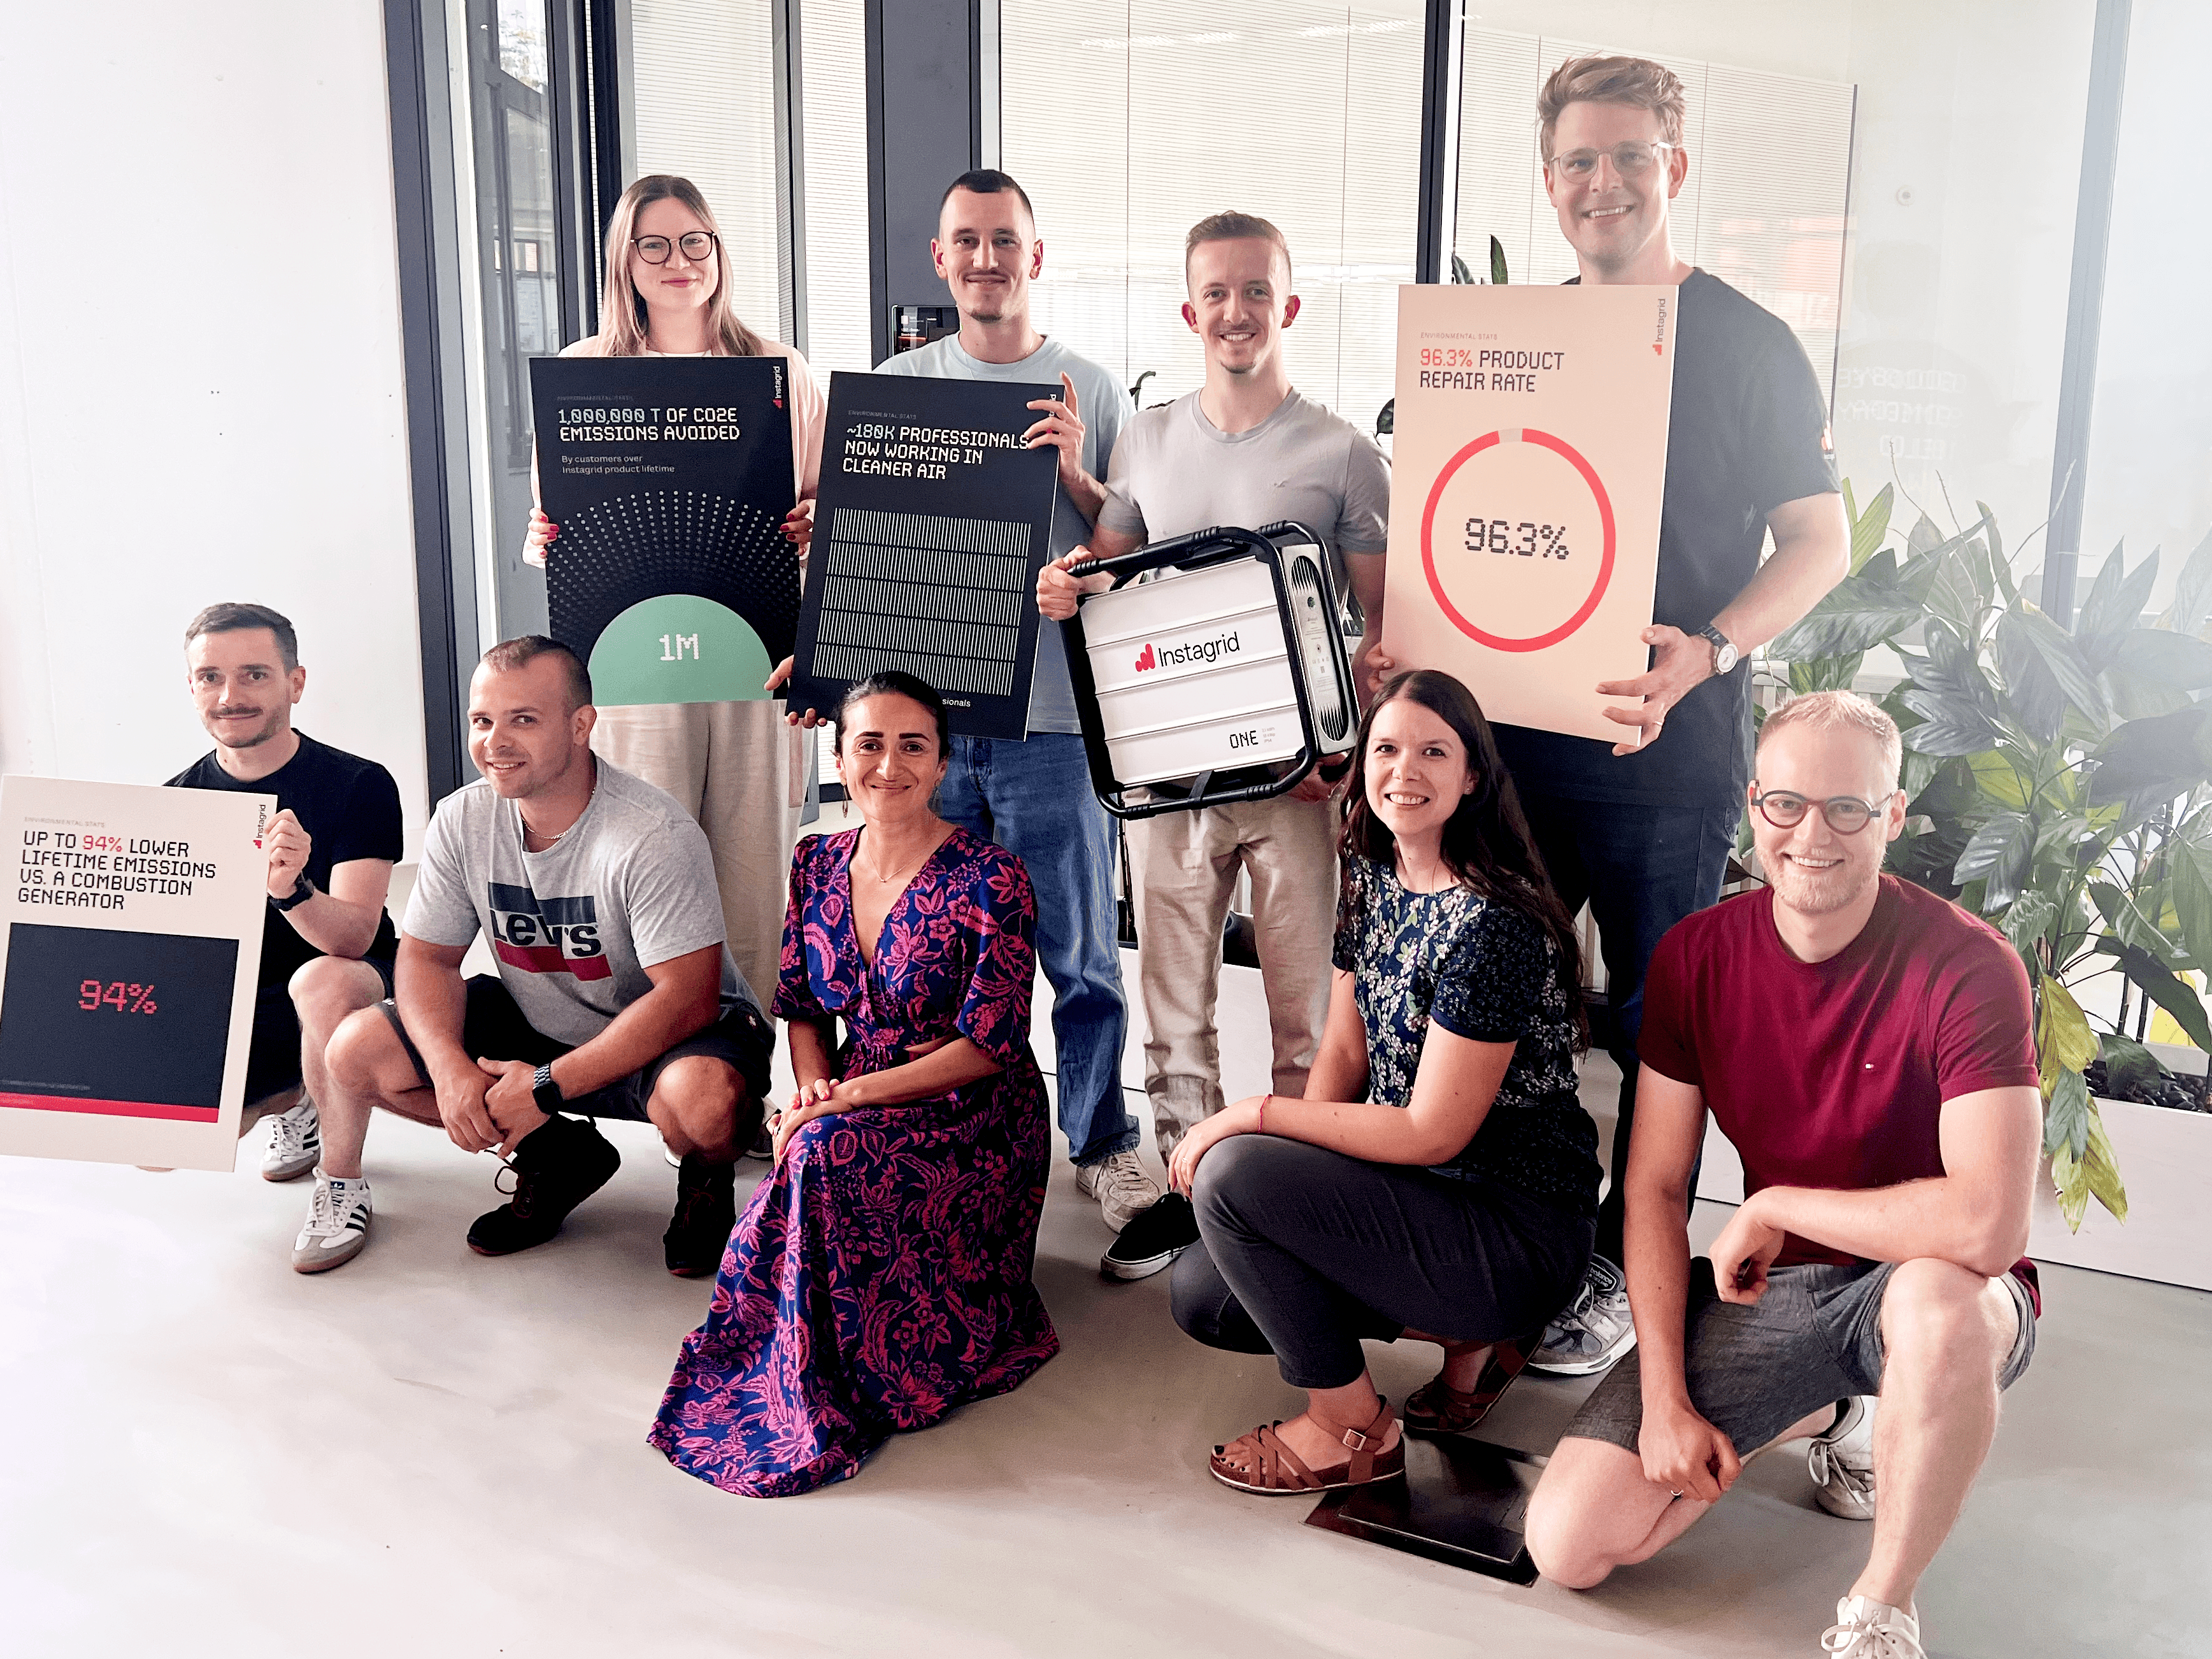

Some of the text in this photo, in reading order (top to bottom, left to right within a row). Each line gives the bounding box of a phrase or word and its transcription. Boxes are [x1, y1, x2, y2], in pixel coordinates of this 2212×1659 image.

[1657, 298, 1667, 342] Instagrid
[1420, 332, 1476, 340] ENVIRONMENTAL
[1420, 349, 1564, 370] 96.3% PRODUCT
[1420, 371, 1536, 392] REPAIR RATE
[558, 408, 737, 425] 1,000,000 T OF CO2E
[560, 425, 740, 441] EMISSIONS AVOIDED
[847, 423, 1029, 450] ~180K PROFESSIONALS
[562, 456, 573, 464] By
[845, 439, 983, 465] NOW WORKING IN
[562, 466, 603, 474] Instagrid
[605, 466, 639, 474] product
[843, 457, 946, 480] CLEANER AIR
[1466, 518, 1569, 559] 96.3%
[659, 634, 699, 660] 1M
[1158, 632, 1240, 667] Instagrid
[942, 698, 971, 707] sionals
[1229, 730, 1259, 749] ONE
[256, 804, 267, 838] Instagrid
[24, 830, 189, 857] UP TO 94% LOWER
[22, 850, 217, 879] LIFETIME EMISSIONS
[20, 869, 192, 895] VS. A COMBUSTION
[18, 888, 124, 909] GENERATOR
[78, 979, 157, 1015] 94%
